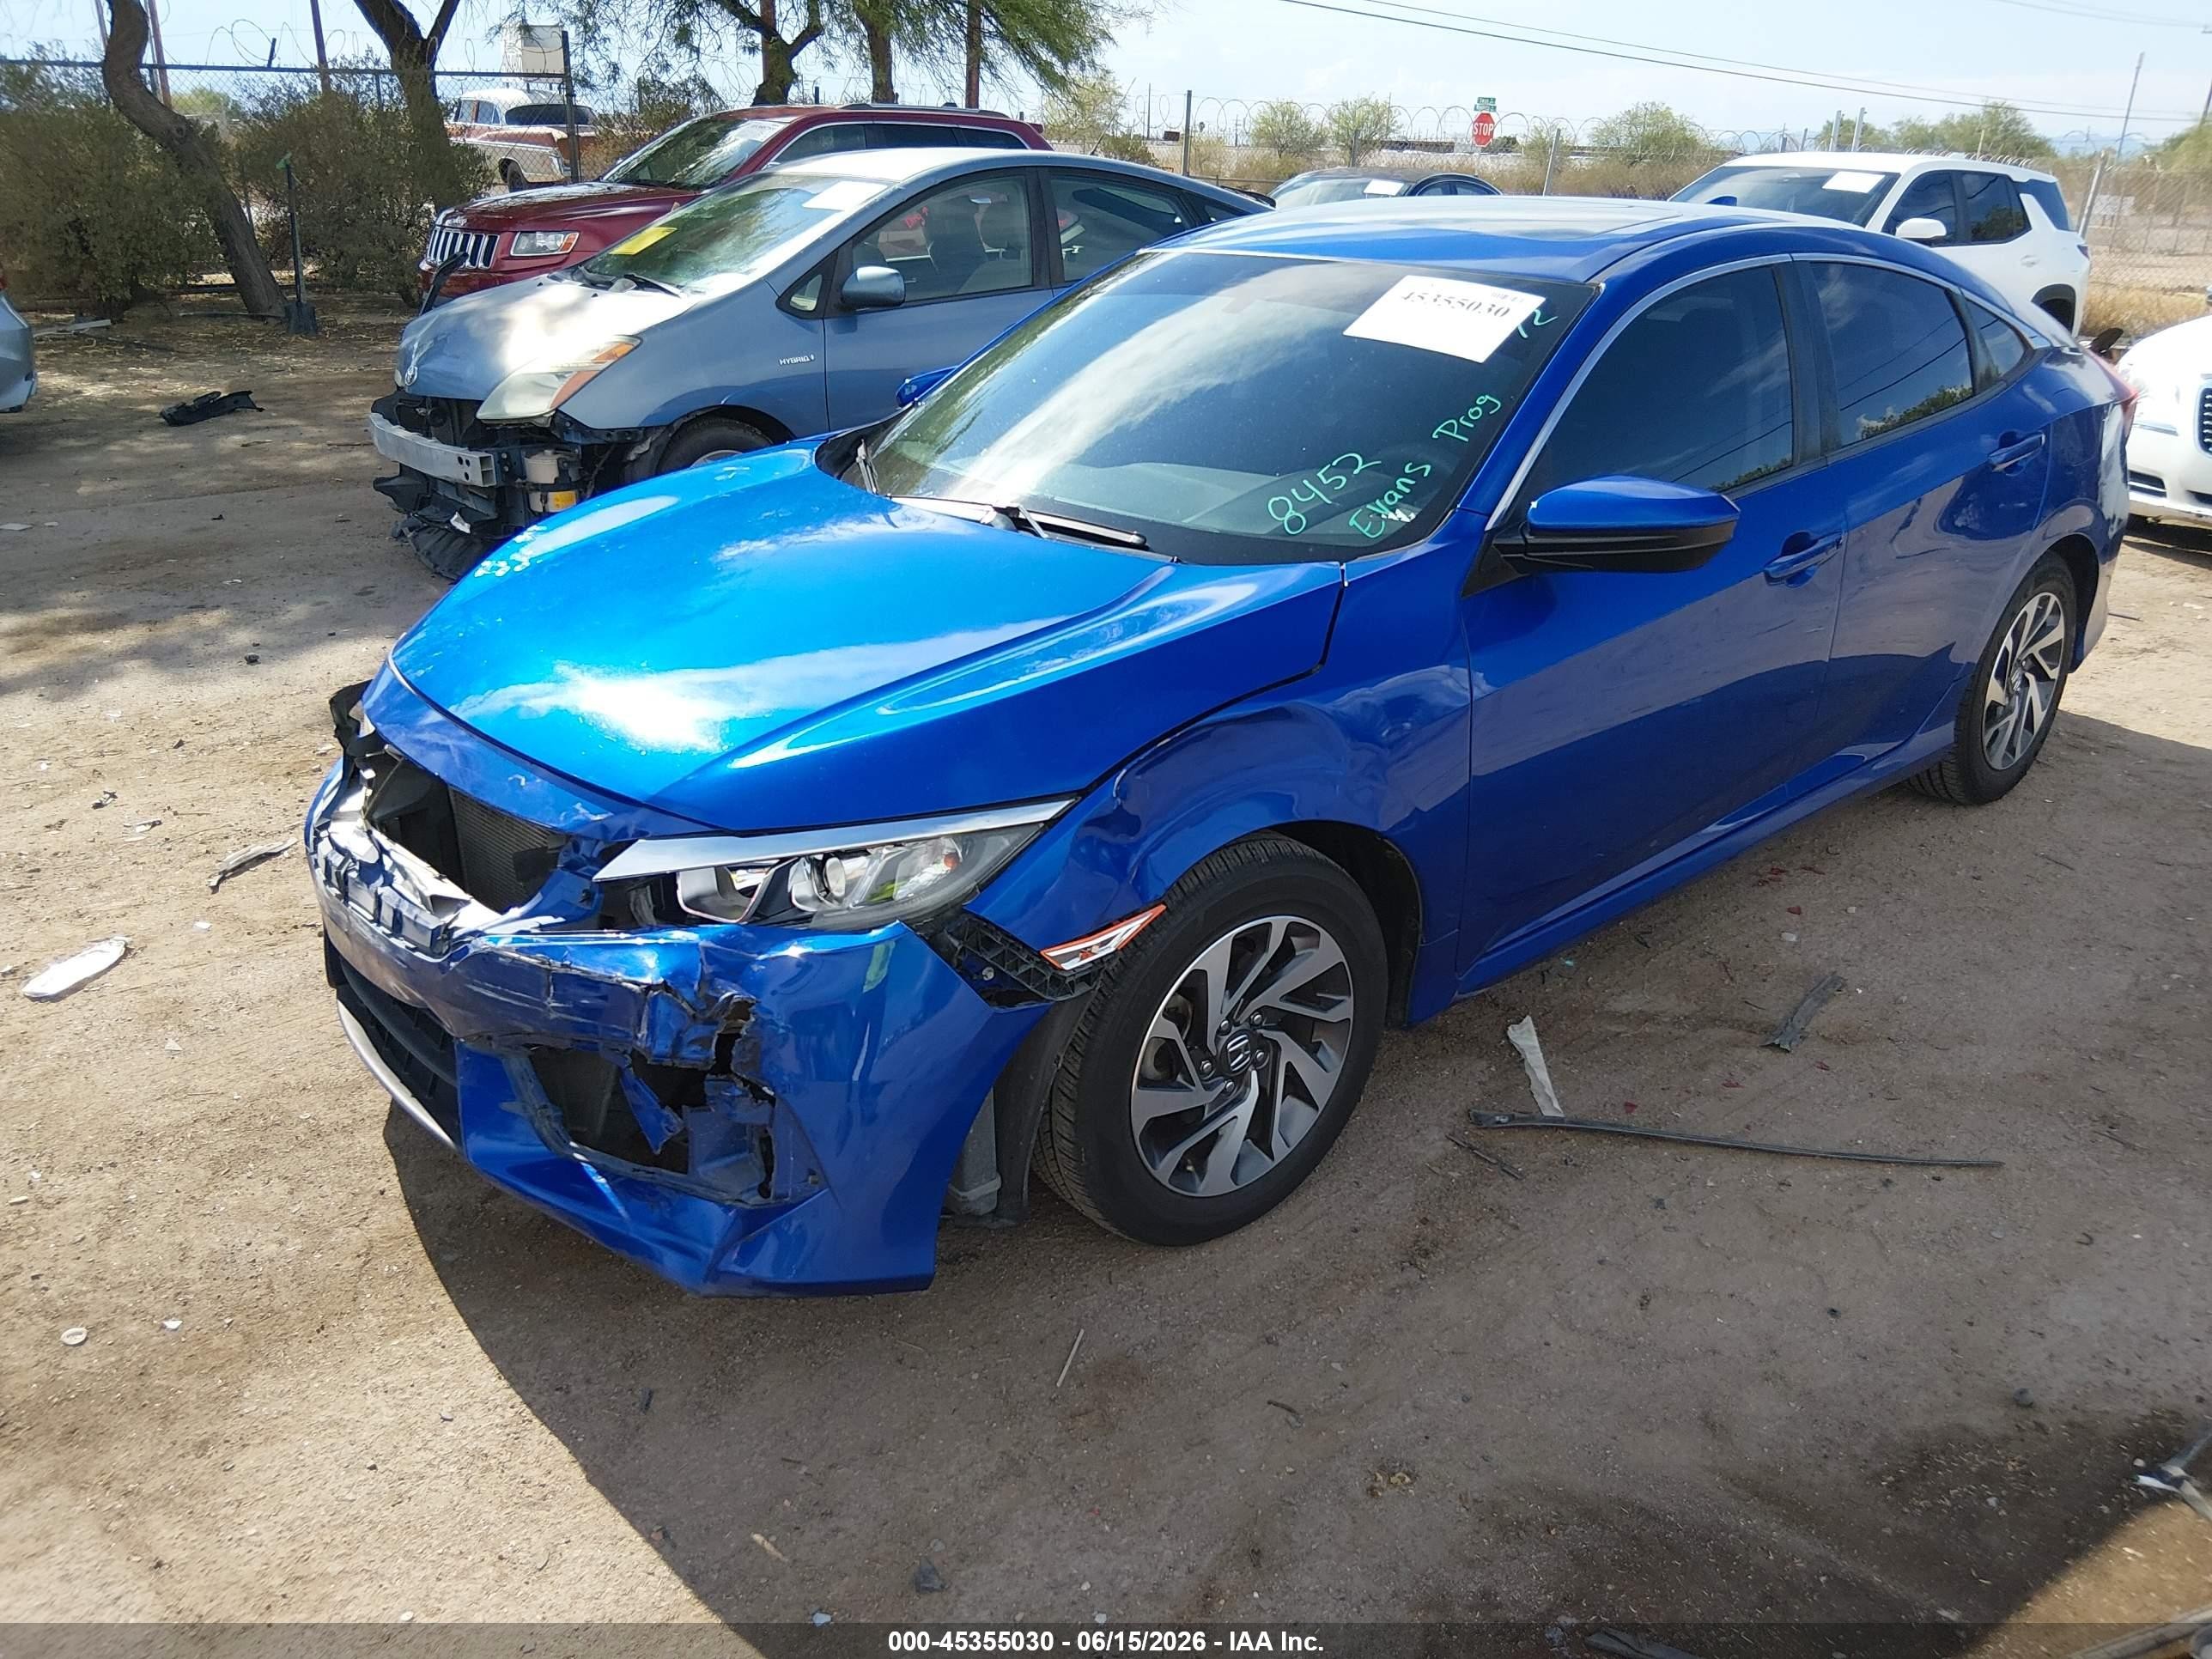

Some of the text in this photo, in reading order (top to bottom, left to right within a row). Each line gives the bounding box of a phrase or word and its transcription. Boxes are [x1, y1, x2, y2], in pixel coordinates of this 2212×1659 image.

[1474, 123, 1494, 136] STOP
[779, 356, 811, 366] HYBRID
[1348, 393, 1502, 539] Evans Prog
[1267, 453, 1382, 535] 8452
